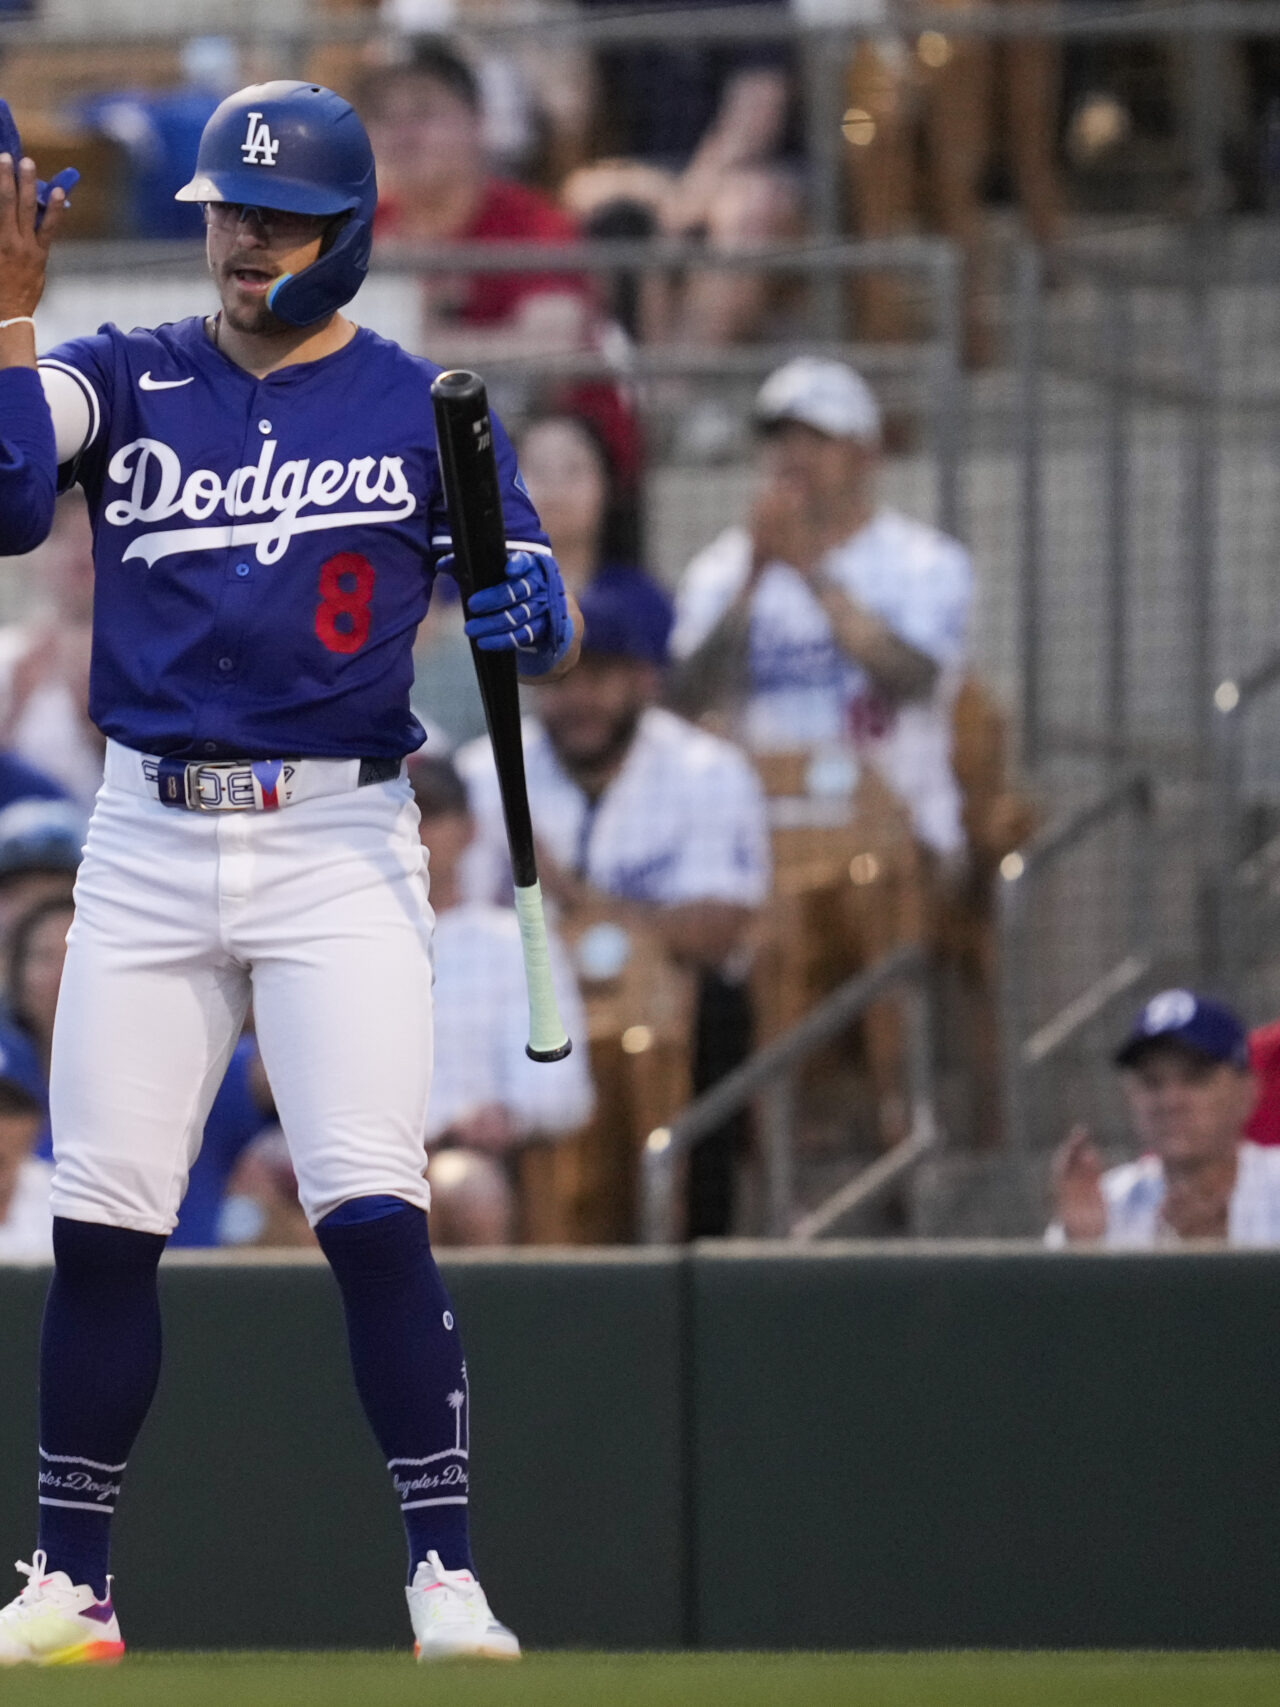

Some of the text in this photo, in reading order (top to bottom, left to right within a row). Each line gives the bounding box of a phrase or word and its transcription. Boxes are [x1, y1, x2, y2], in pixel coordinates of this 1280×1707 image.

[240, 112, 280, 166] LA
[105, 437, 417, 566] Dodgers
[315, 551, 375, 654] 8
